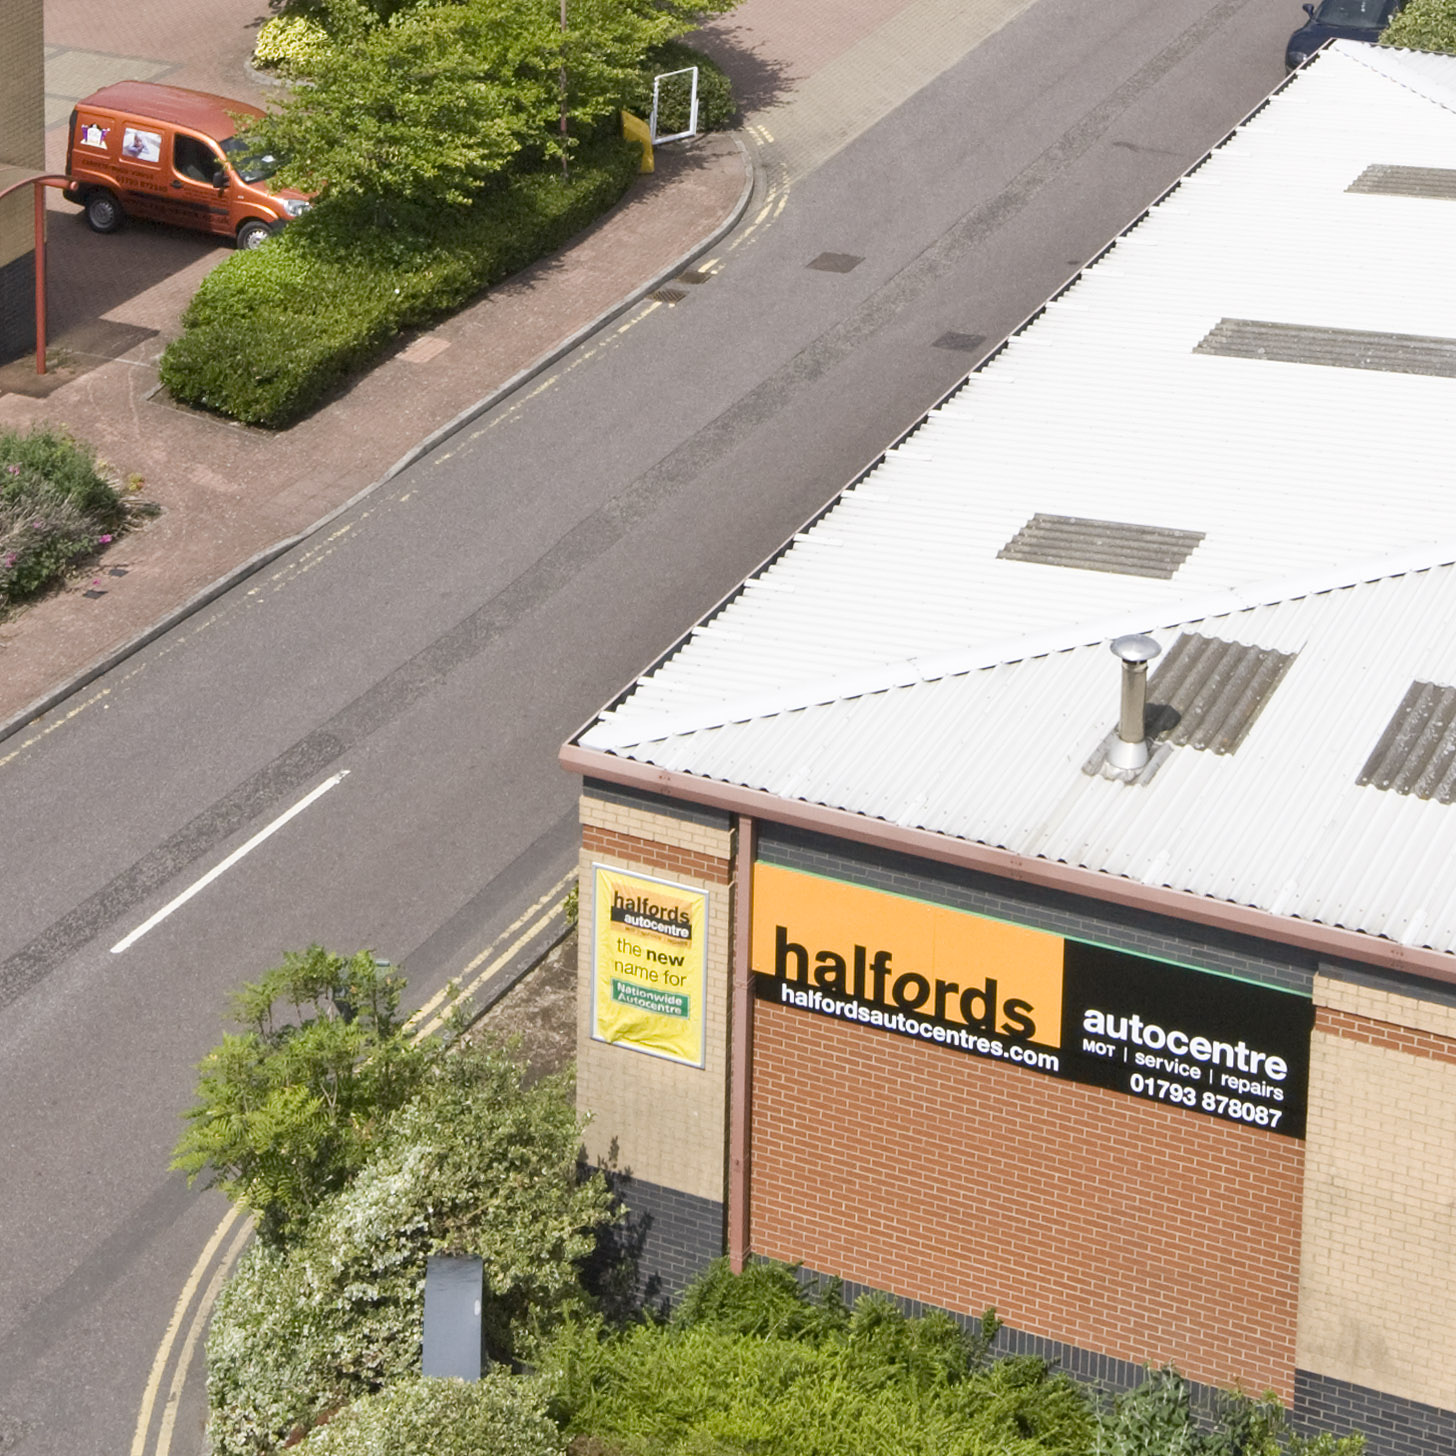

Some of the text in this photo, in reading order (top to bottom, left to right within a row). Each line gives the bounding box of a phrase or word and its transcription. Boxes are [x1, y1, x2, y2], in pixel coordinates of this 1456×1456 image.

[614, 891, 691, 924] halfords
[624, 913, 690, 938] autocentre
[617, 937, 685, 966] the new
[614, 960, 687, 987] name for
[775, 925, 1037, 1041] halfords
[617, 982, 683, 1006] Nationwide
[617, 993, 683, 1015] Autocentre
[781, 983, 1060, 1072] halfordsautocentres.com
[1083, 1009, 1288, 1081] autocentre
[1082, 1038, 1285, 1102] MOT service repairs
[1130, 1073, 1283, 1128] 01793 878087
